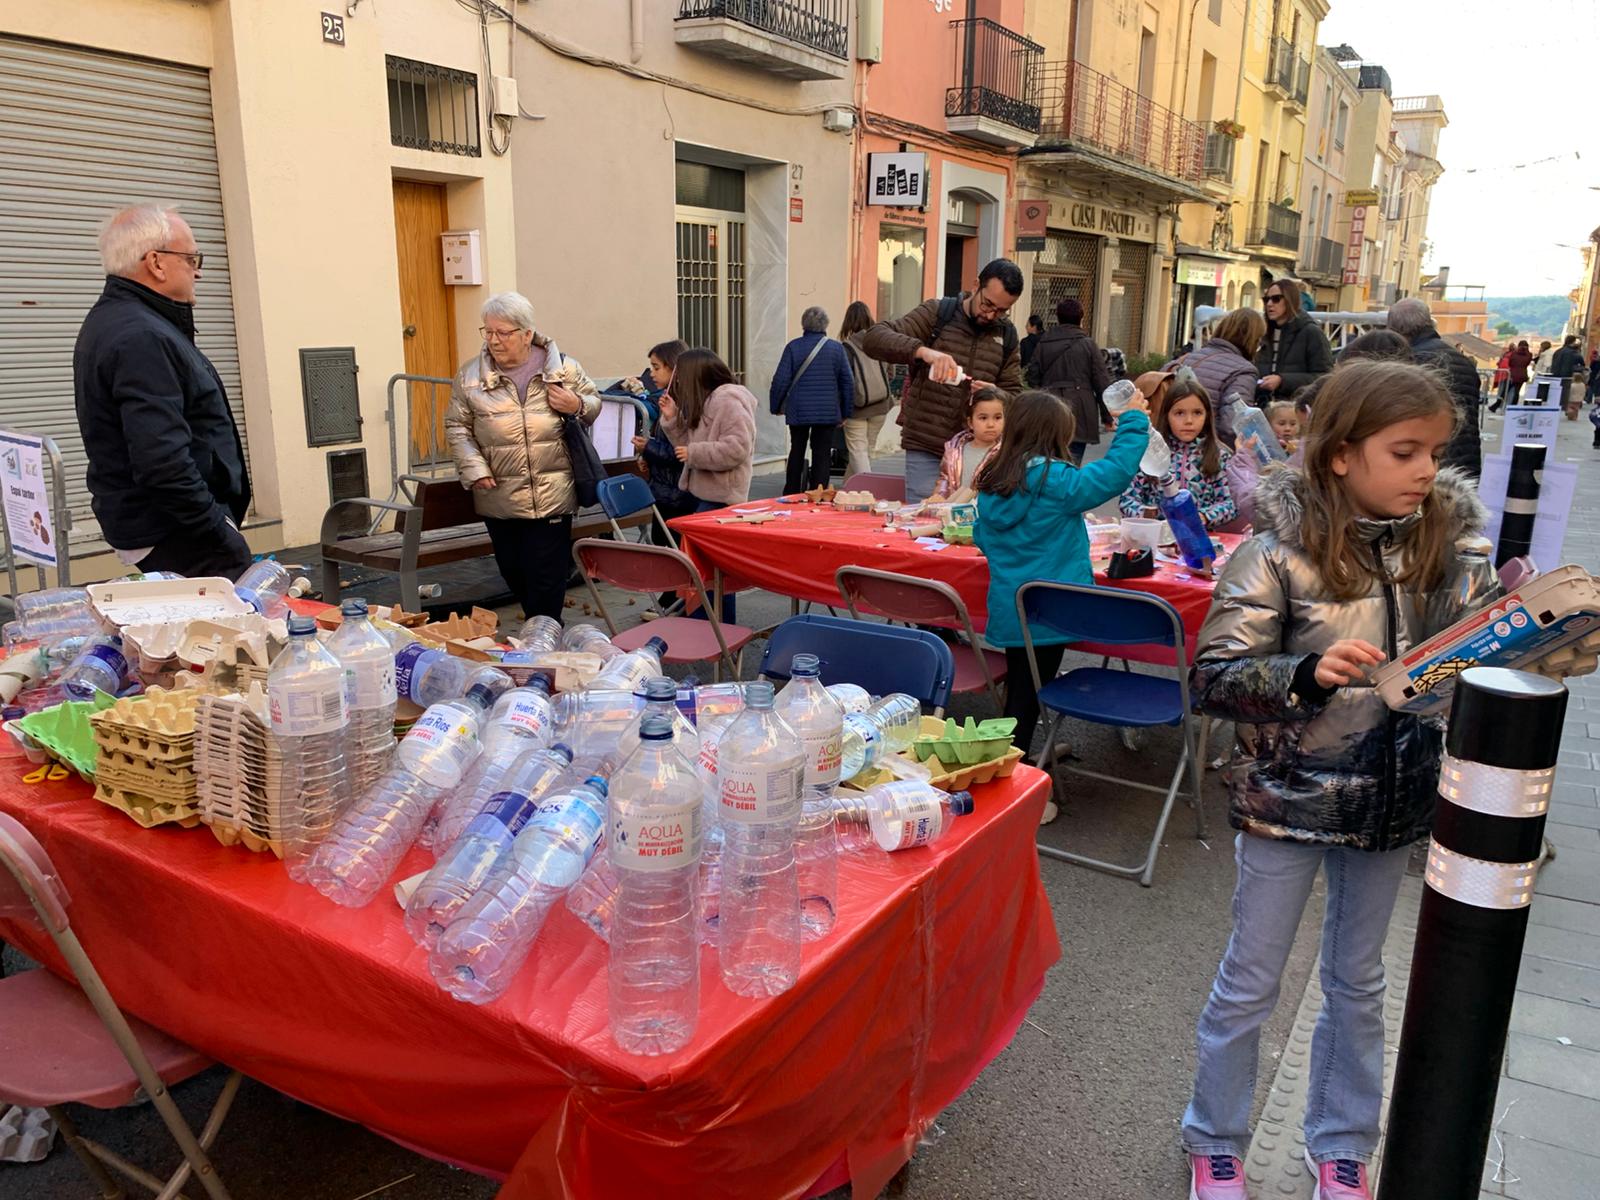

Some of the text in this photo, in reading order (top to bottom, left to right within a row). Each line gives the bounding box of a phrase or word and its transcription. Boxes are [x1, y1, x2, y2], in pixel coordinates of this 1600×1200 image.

[322, 16, 344, 42] 25
[791, 163, 804, 181] 27
[887, 169, 896, 194] CEN
[897, 174, 908, 193] TRA
[1071, 203, 1096, 229] CASA
[1345, 206, 1366, 283] ORIENT
[721, 777, 756, 794] AQUA
[735, 801, 757, 812] DÉBIL
[638, 823, 684, 841] AQUA
[638, 845, 684, 857] MUY DÉBIL
